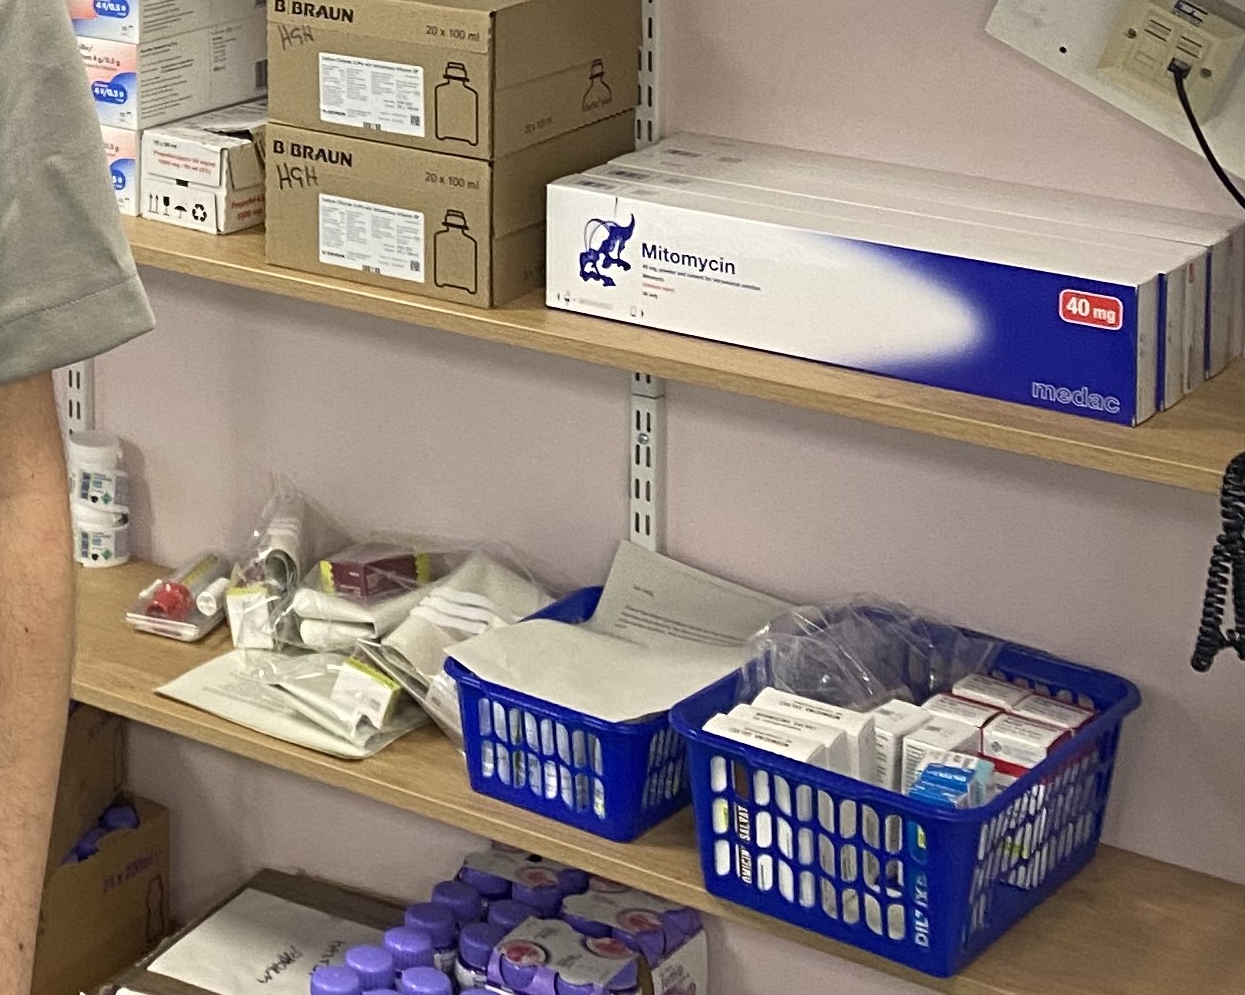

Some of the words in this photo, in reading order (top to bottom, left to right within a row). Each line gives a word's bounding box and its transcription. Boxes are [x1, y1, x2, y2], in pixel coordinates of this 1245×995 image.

[292, 1, 354, 23] BRAUN
[426, 25, 437, 35] 20
[439, 29, 445, 37] x
[449, 29, 465, 41] 100
[467, 32, 480, 42] ml
[273, 140, 284, 154] B
[291, 143, 353, 167] BRAUN
[425, 172, 436, 183] 20
[438, 176, 445, 184] x
[449, 176, 466, 188] 100
[467, 180, 479, 190] ml
[641, 242, 736, 275] Mitomycin
[1066, 296, 1090, 317] 40
[1092, 306, 1116, 324] mg
[1032, 380, 1120, 413] medac
